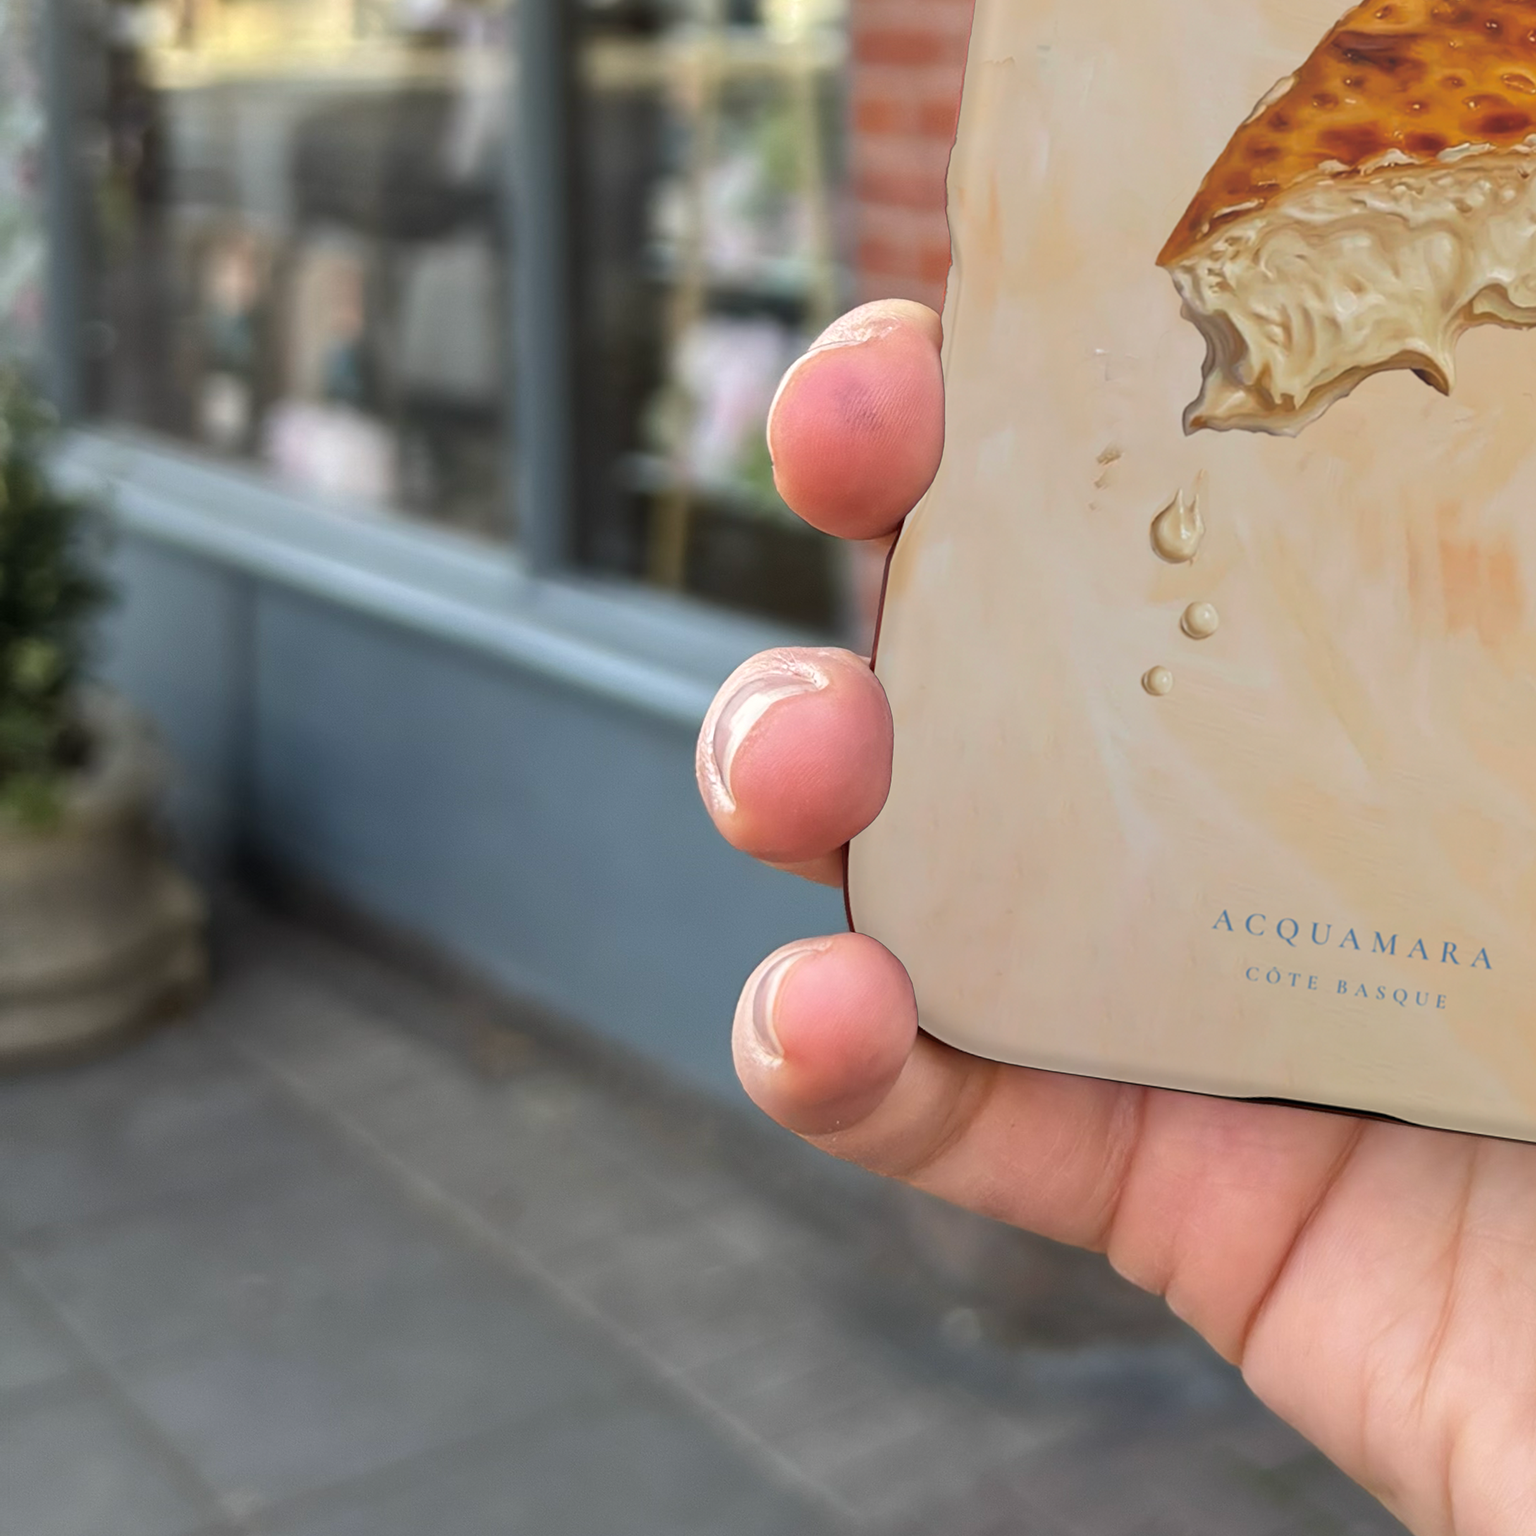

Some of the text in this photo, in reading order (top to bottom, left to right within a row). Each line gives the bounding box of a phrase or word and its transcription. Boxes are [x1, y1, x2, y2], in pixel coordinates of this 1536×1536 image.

[1211, 909, 1493, 970] ACQUAMARA
[1245, 966, 1447, 1010] CÔTE BASQUE
